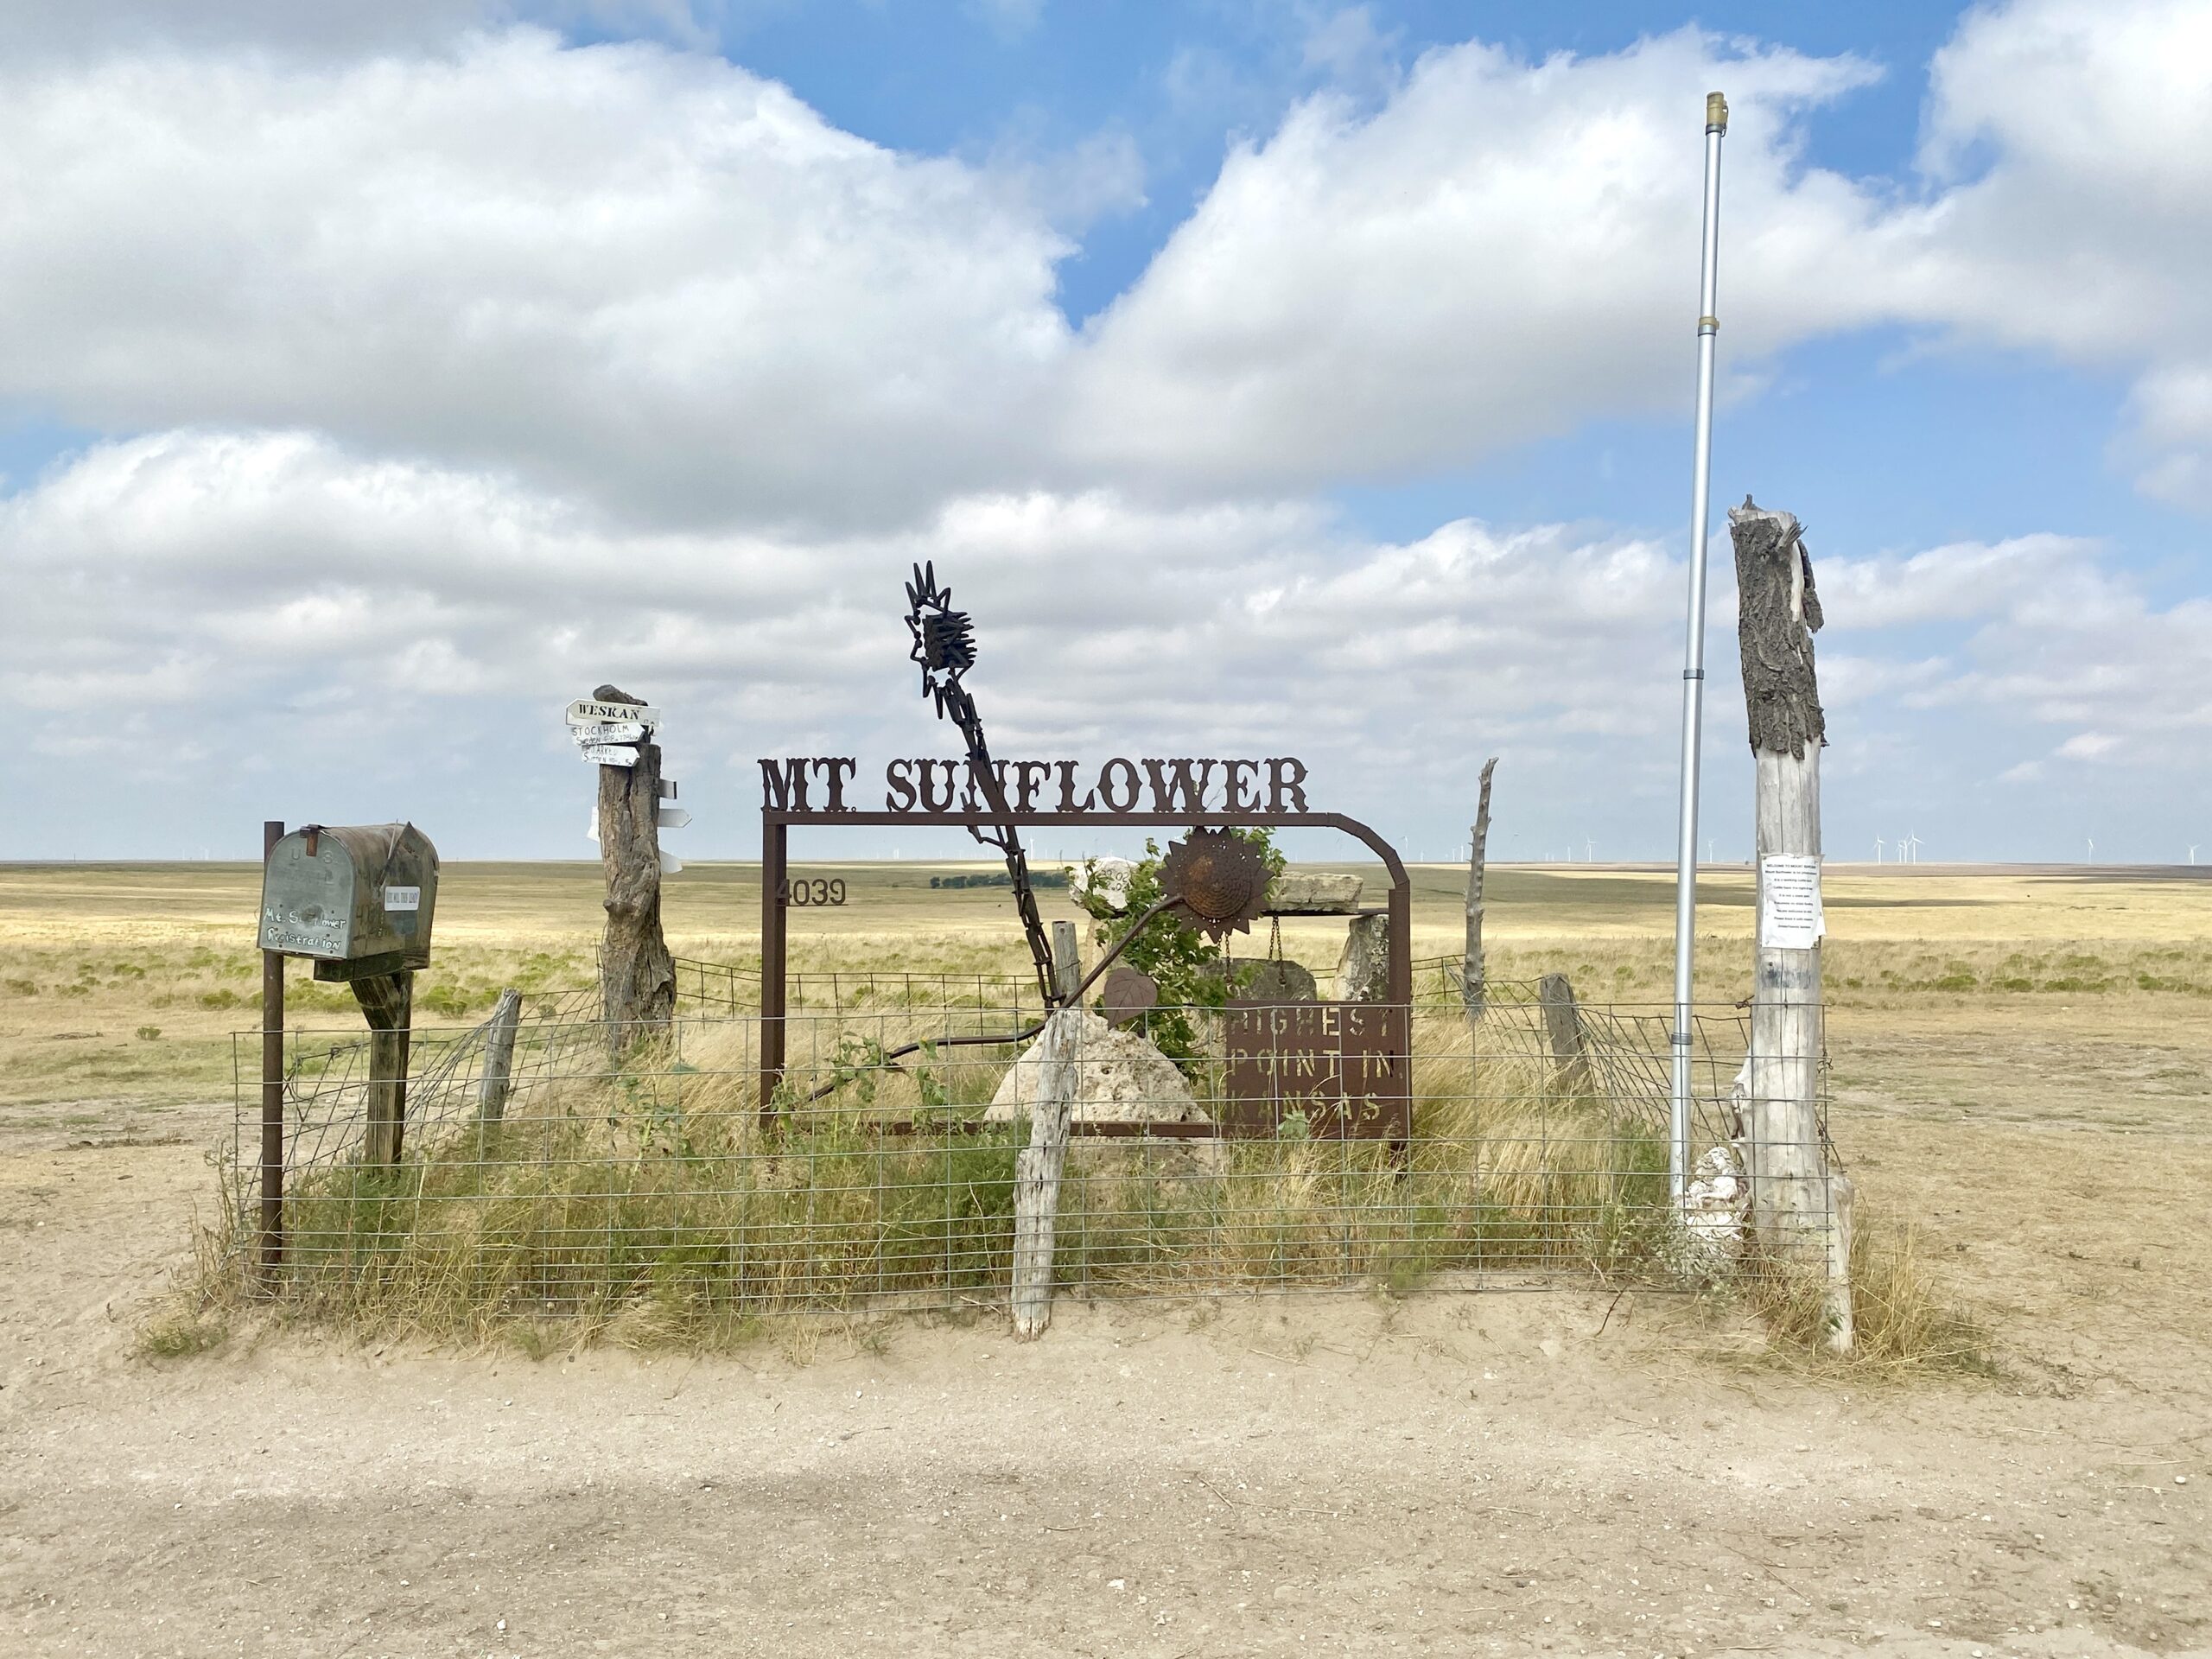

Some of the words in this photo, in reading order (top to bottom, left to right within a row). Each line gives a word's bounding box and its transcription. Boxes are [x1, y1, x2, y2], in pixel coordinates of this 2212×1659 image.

[578, 703, 639, 721] WESKAN
[571, 724, 630, 737] STOCKHOLM
[757, 757, 857, 813] MT.
[886, 757, 1309, 813] SUNFLOWER
[778, 878, 847, 906] 4039
[1230, 1007, 1393, 1037] HIGHEST
[1230, 1047, 1340, 1077] POINT
[1362, 1049, 1395, 1078] IN
[1230, 1090, 1381, 1121] KANSAS
